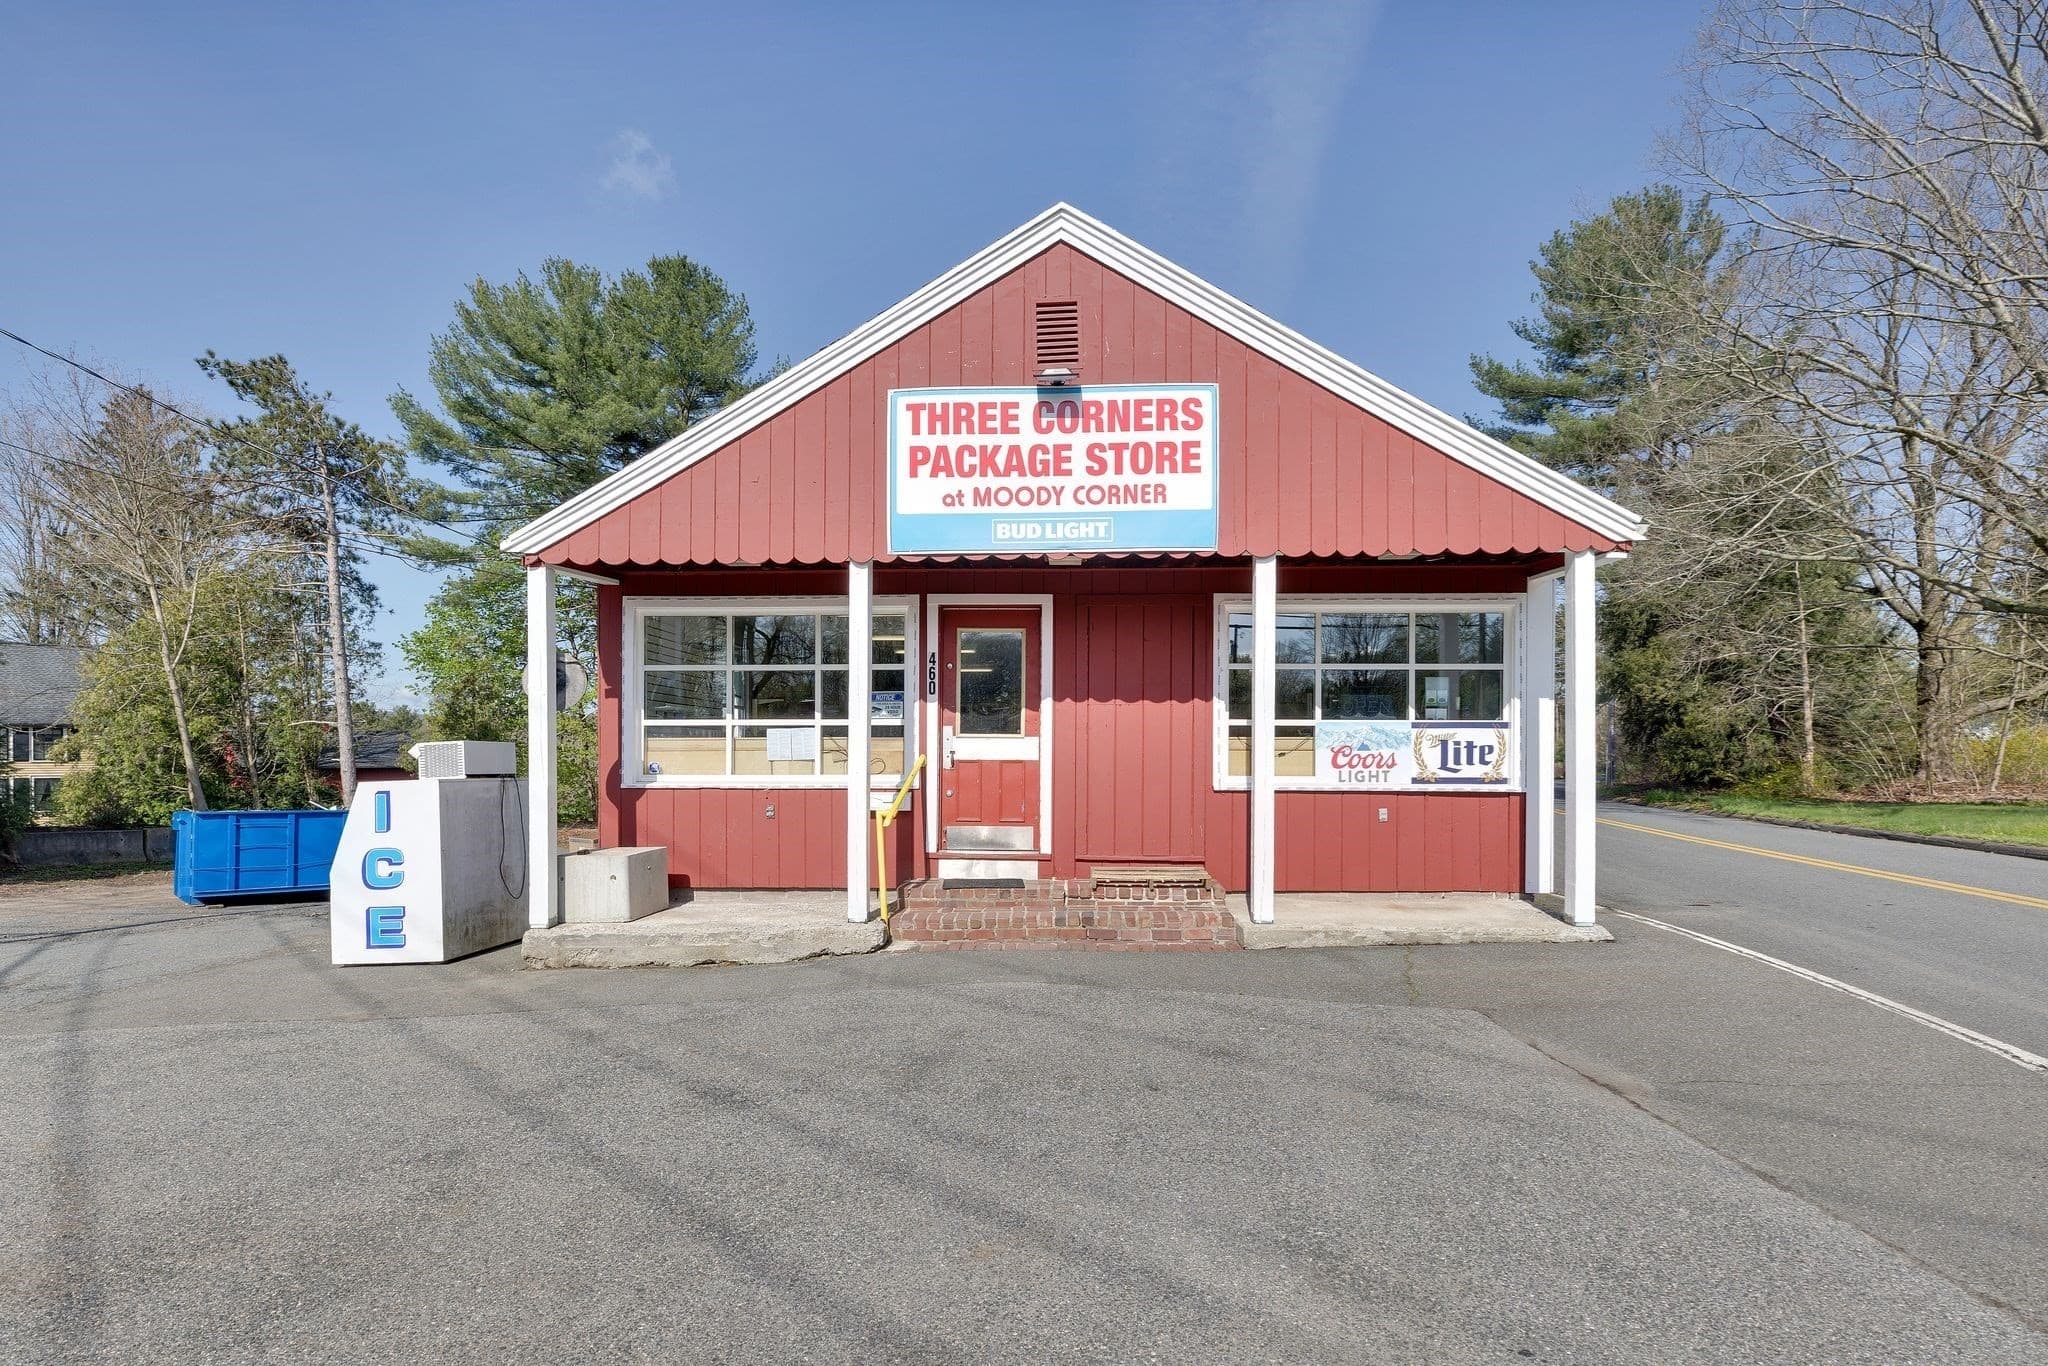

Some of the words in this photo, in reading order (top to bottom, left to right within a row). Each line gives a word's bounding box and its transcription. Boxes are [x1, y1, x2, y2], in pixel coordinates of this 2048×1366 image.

[906, 401, 1020, 435] THREE
[1033, 398, 1204, 434] CORNERS
[909, 444, 1072, 478] PACKAGE
[1085, 441, 1201, 476] STORE
[942, 489, 965, 507] at
[973, 486, 1065, 507] MOODY
[1073, 484, 1167, 505] CORNER
[996, 523, 1042, 539] BUD
[1045, 521, 1109, 539] LIGHT
[1424, 732, 1459, 748] Miller
[1330, 745, 1398, 769] Coors
[1437, 739, 1495, 773] Lite
[1338, 770, 1391, 783] LIGHT
[361, 790, 407, 949] ICE
